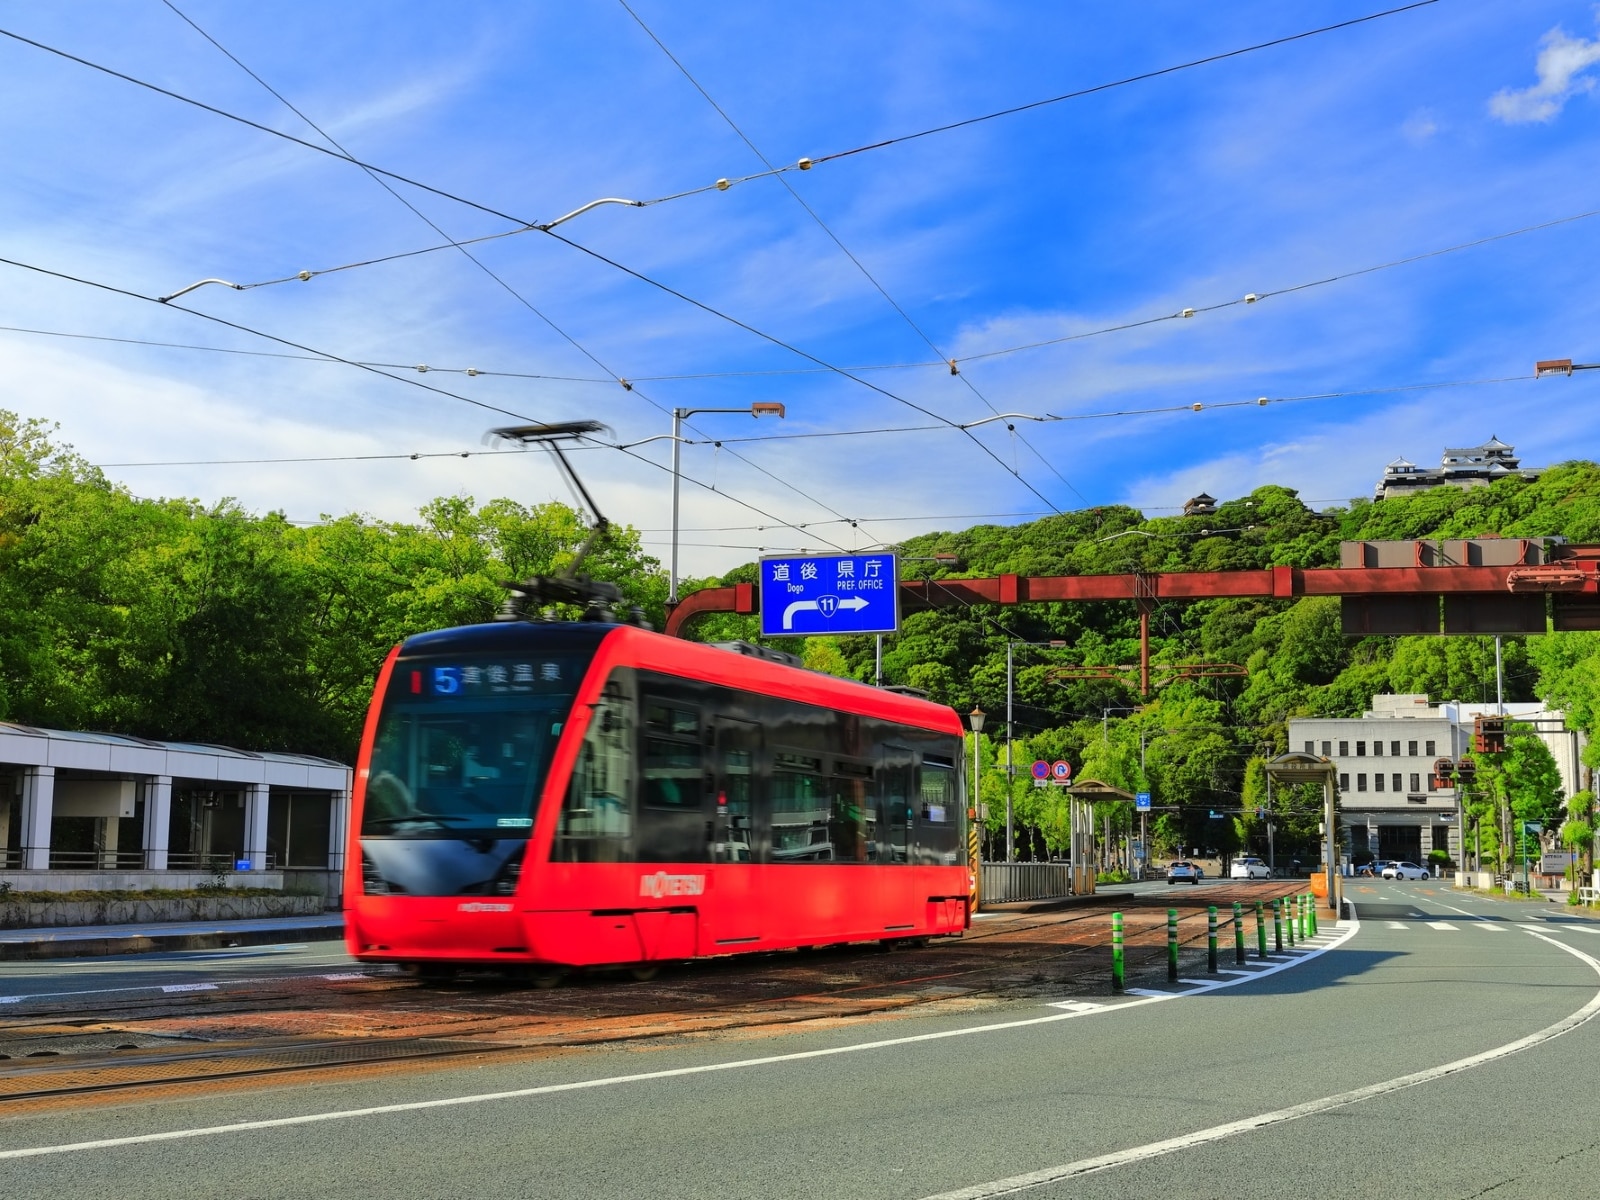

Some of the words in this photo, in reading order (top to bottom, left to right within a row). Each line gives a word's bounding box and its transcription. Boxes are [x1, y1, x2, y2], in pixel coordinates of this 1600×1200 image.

[772, 562, 818, 581] 道後
[837, 559, 882, 578] 県庁
[787, 583, 804, 594] Dogo
[837, 580, 857, 590] PREF.
[858, 579, 883, 590] OFFICE
[820, 598, 834, 611] 11
[434, 666, 459, 693] 5
